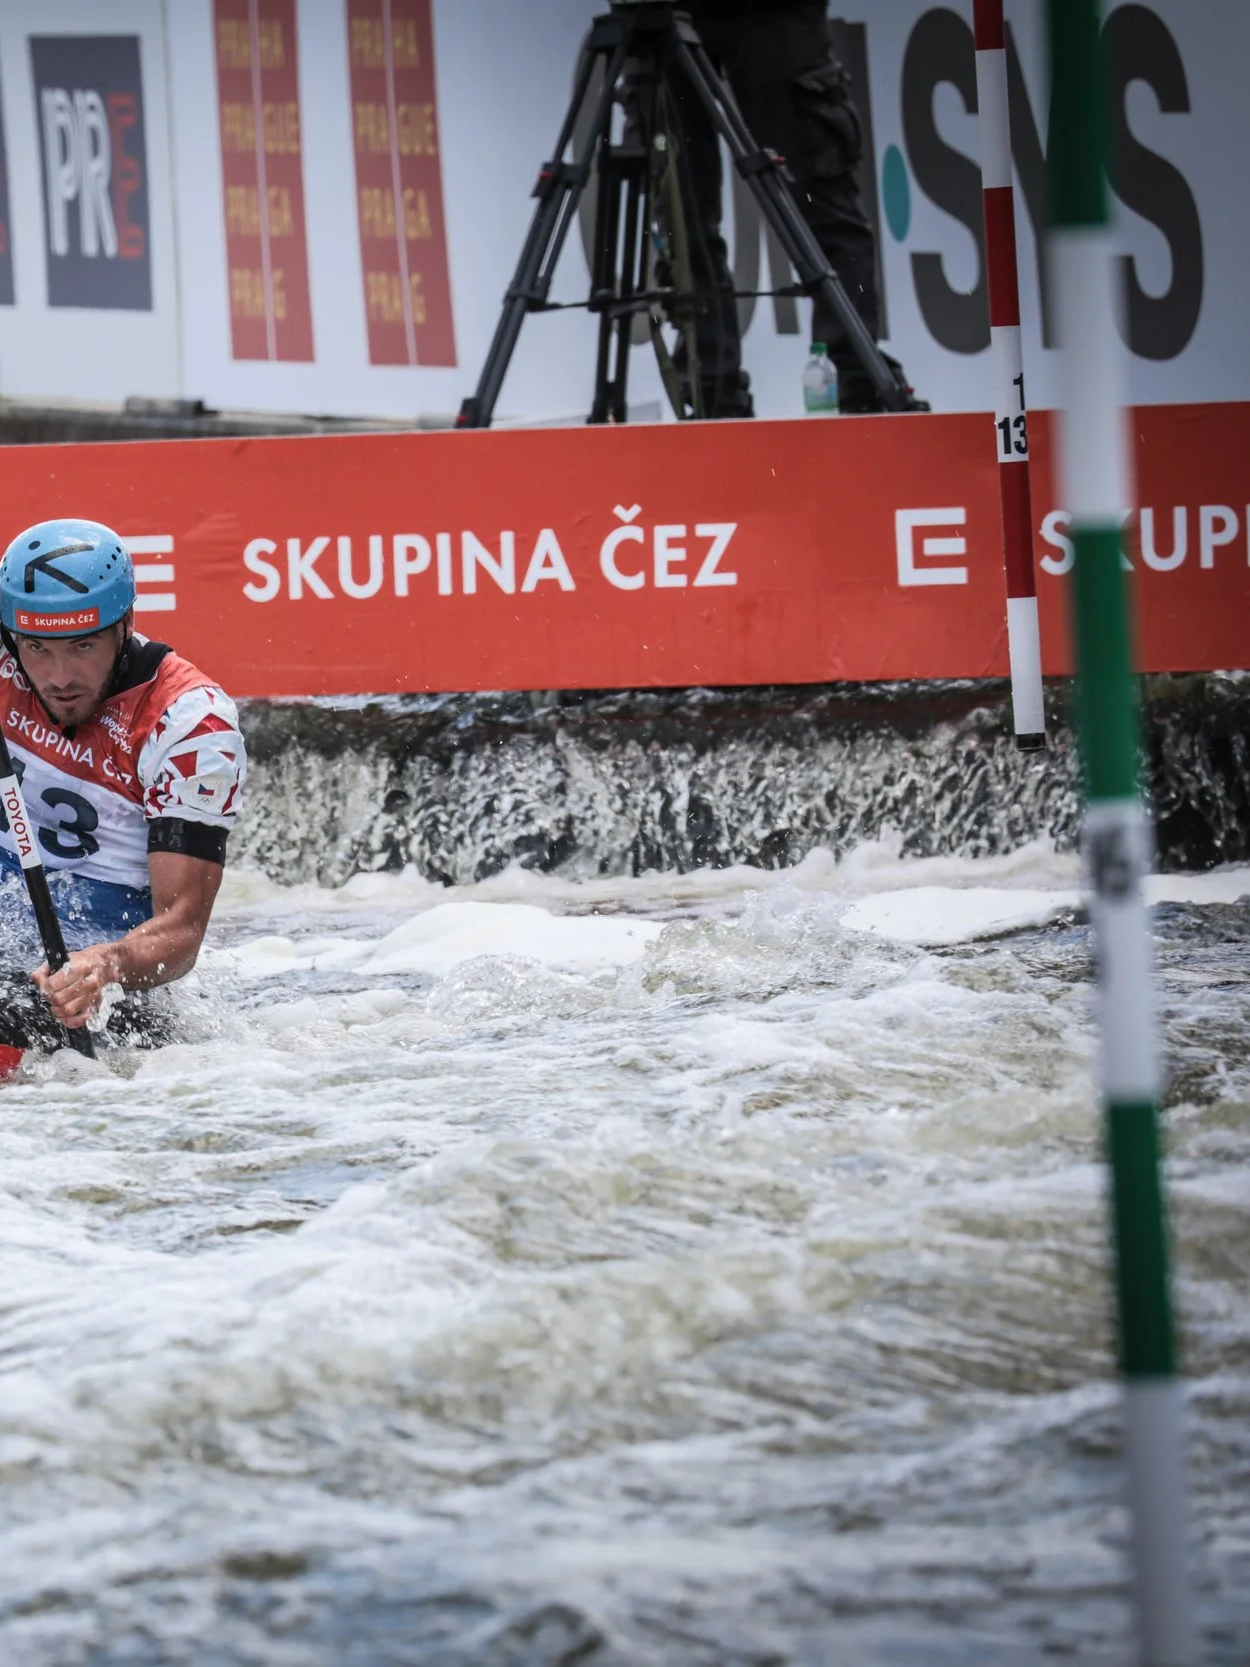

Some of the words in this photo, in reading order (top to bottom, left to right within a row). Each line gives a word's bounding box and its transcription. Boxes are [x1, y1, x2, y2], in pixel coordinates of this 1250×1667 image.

[997, 415, 1028, 455] 13
[242, 529, 575, 602] SKUPINA
[600, 503, 738, 591] ČEZ
[1039, 504, 1250, 575] SUP
[34, 618, 76, 626] SKUPINA
[78, 614, 94, 624] ČEZ
[6, 709, 94, 768] SKUPINA
[102, 754, 132, 786] ČZ
[4, 787, 32, 857] TOYOTA
